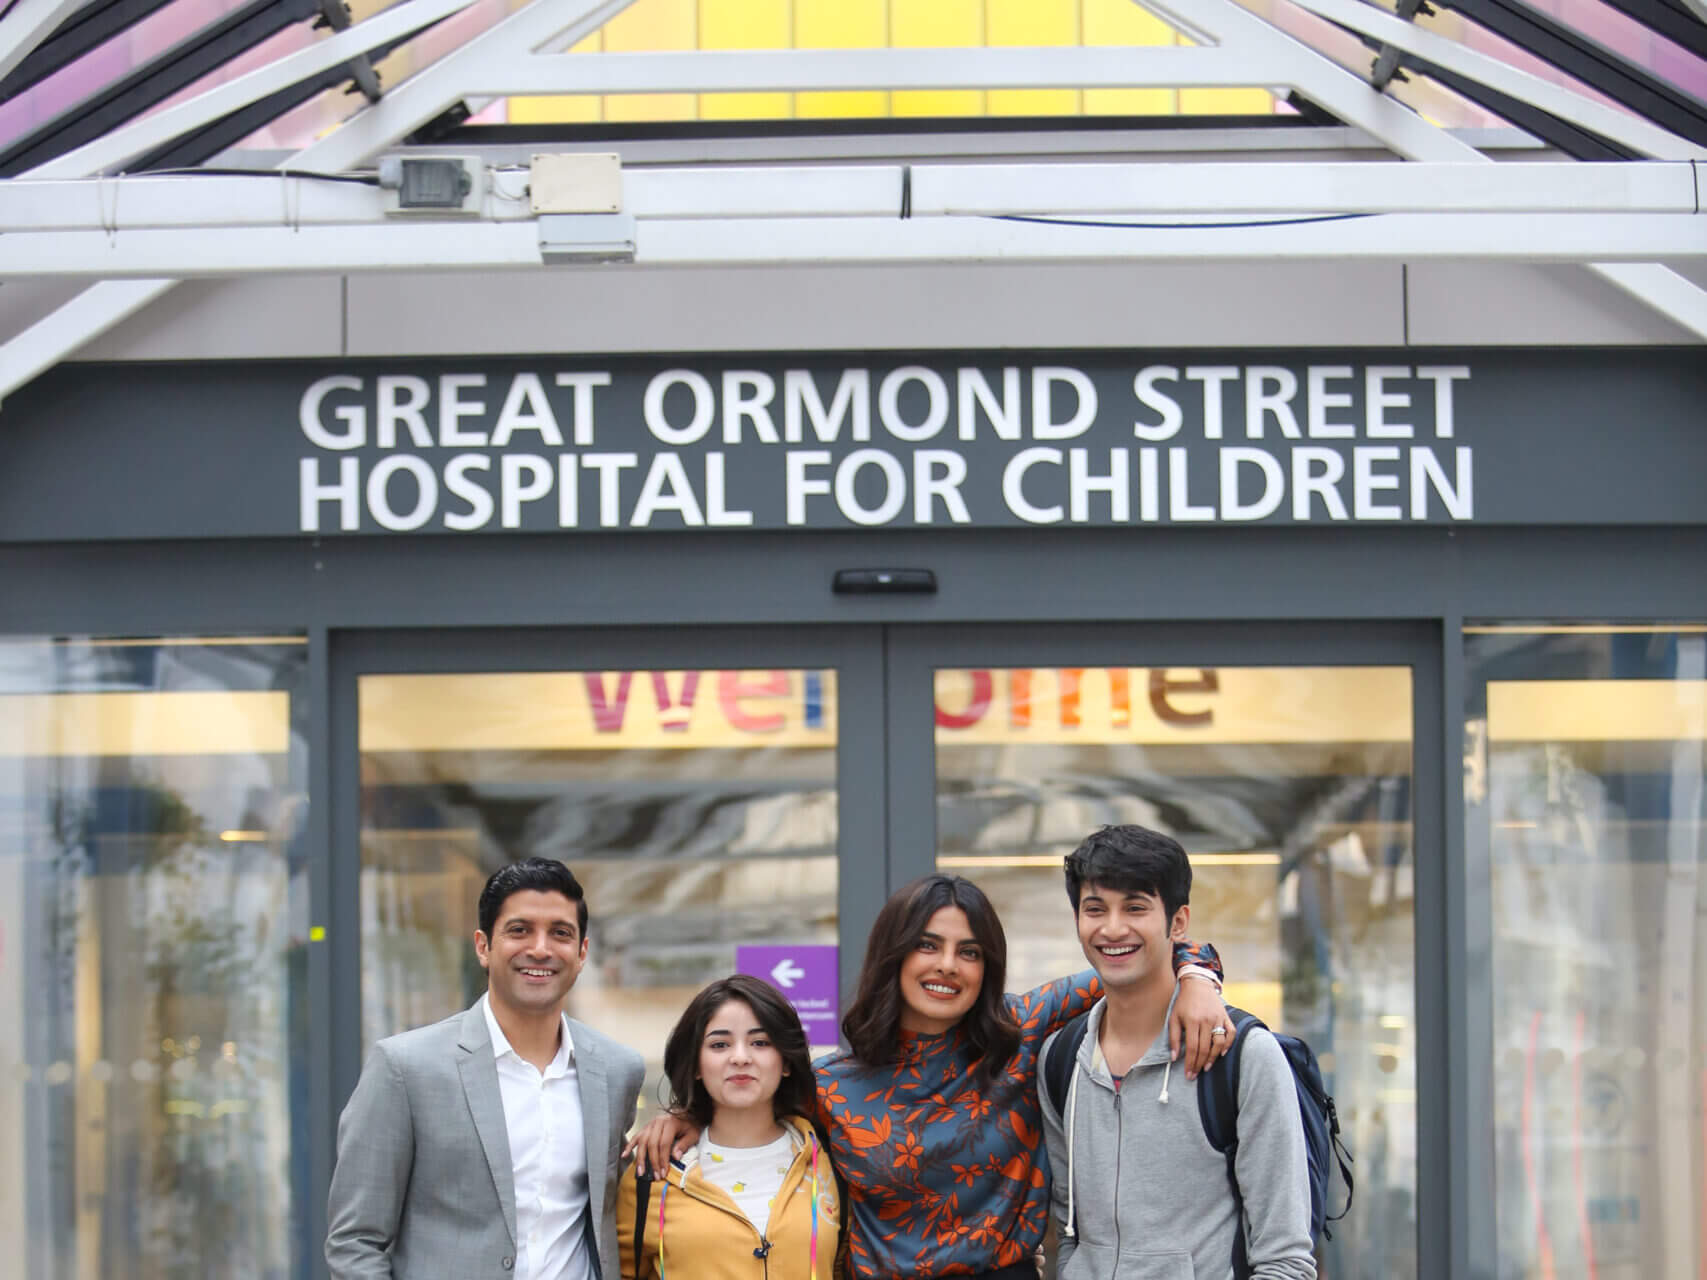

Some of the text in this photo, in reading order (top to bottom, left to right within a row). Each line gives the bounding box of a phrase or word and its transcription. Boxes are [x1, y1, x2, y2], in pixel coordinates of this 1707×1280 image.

[299, 365, 1471, 450] GREAT ORMOND STREET
[299, 445, 1474, 532] HOSPITAL FOR CHILDREN
[581, 669, 1219, 732] Welome
